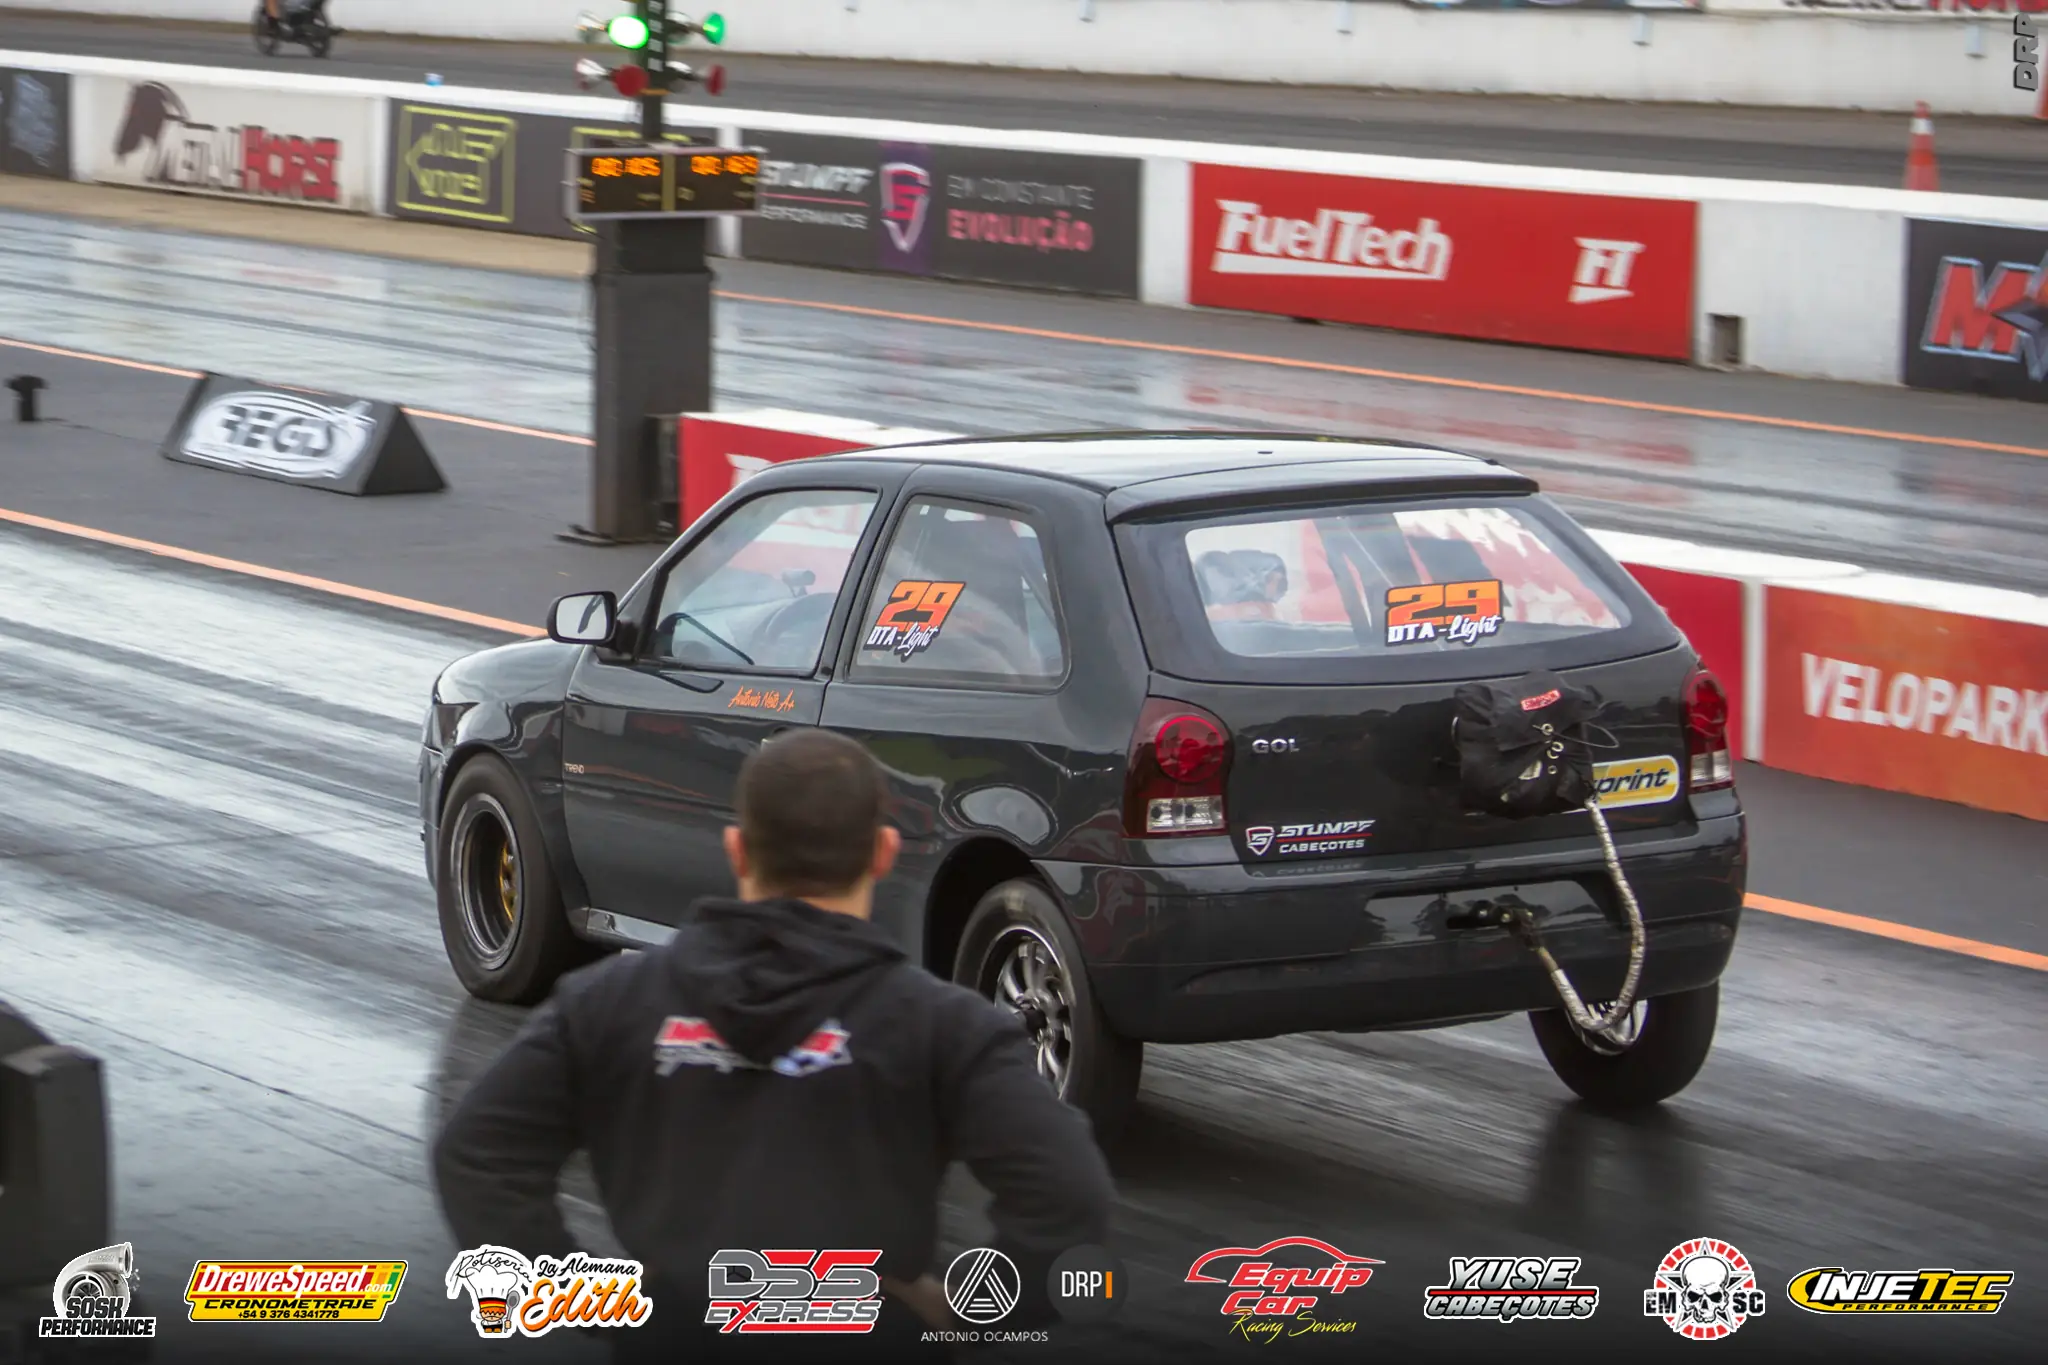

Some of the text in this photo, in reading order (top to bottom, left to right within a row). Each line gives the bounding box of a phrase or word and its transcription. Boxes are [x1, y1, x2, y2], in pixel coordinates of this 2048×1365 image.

[760, 204, 868, 229] ERFORMANCE
[947, 208, 1093, 254] EVOLUÇÃO
[1215, 199, 1452, 270] FuelTech
[876, 581, 965, 632] 29
[1388, 580, 1500, 625] 29
[1801, 652, 2048, 757] VELOPARK
[1252, 738, 1299, 753] GOL
[1276, 819, 1376, 838] STUMPF
[1279, 839, 1365, 853] CABEÇOTES
